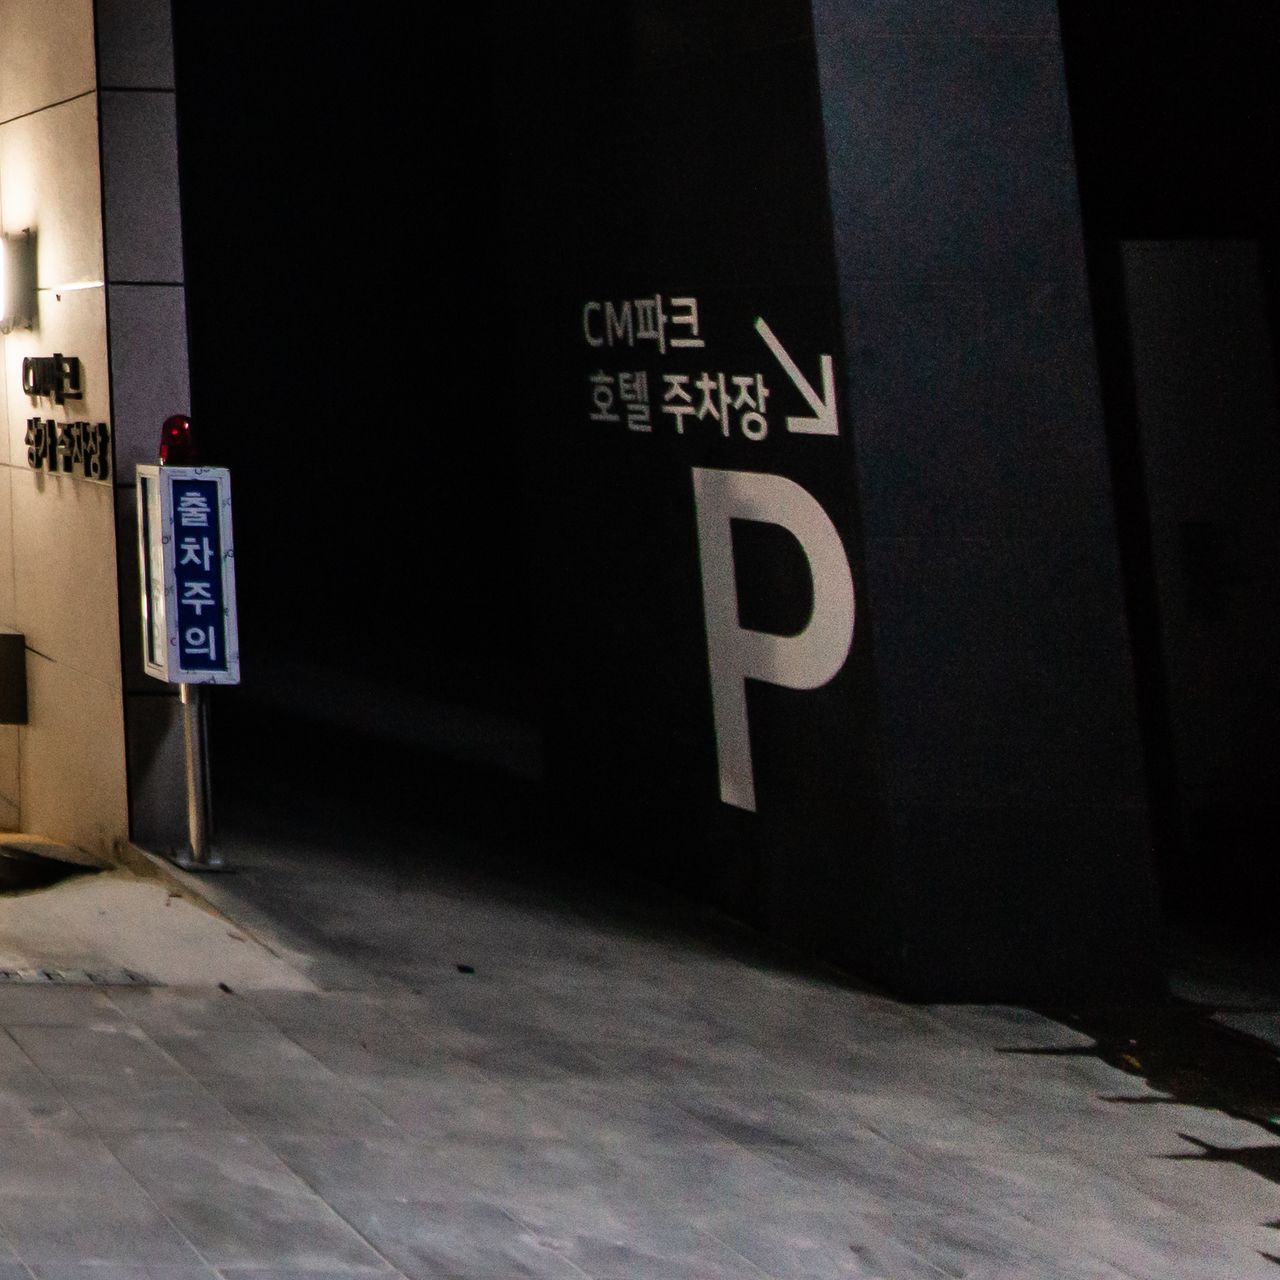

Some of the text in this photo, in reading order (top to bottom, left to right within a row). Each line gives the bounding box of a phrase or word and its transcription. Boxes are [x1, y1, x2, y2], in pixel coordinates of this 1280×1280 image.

[583, 293, 705, 355] CM파크
[588, 370, 770, 442] 호텔 주차장
[177, 491, 217, 662] 출차주의
[692, 467, 855, 813] P
